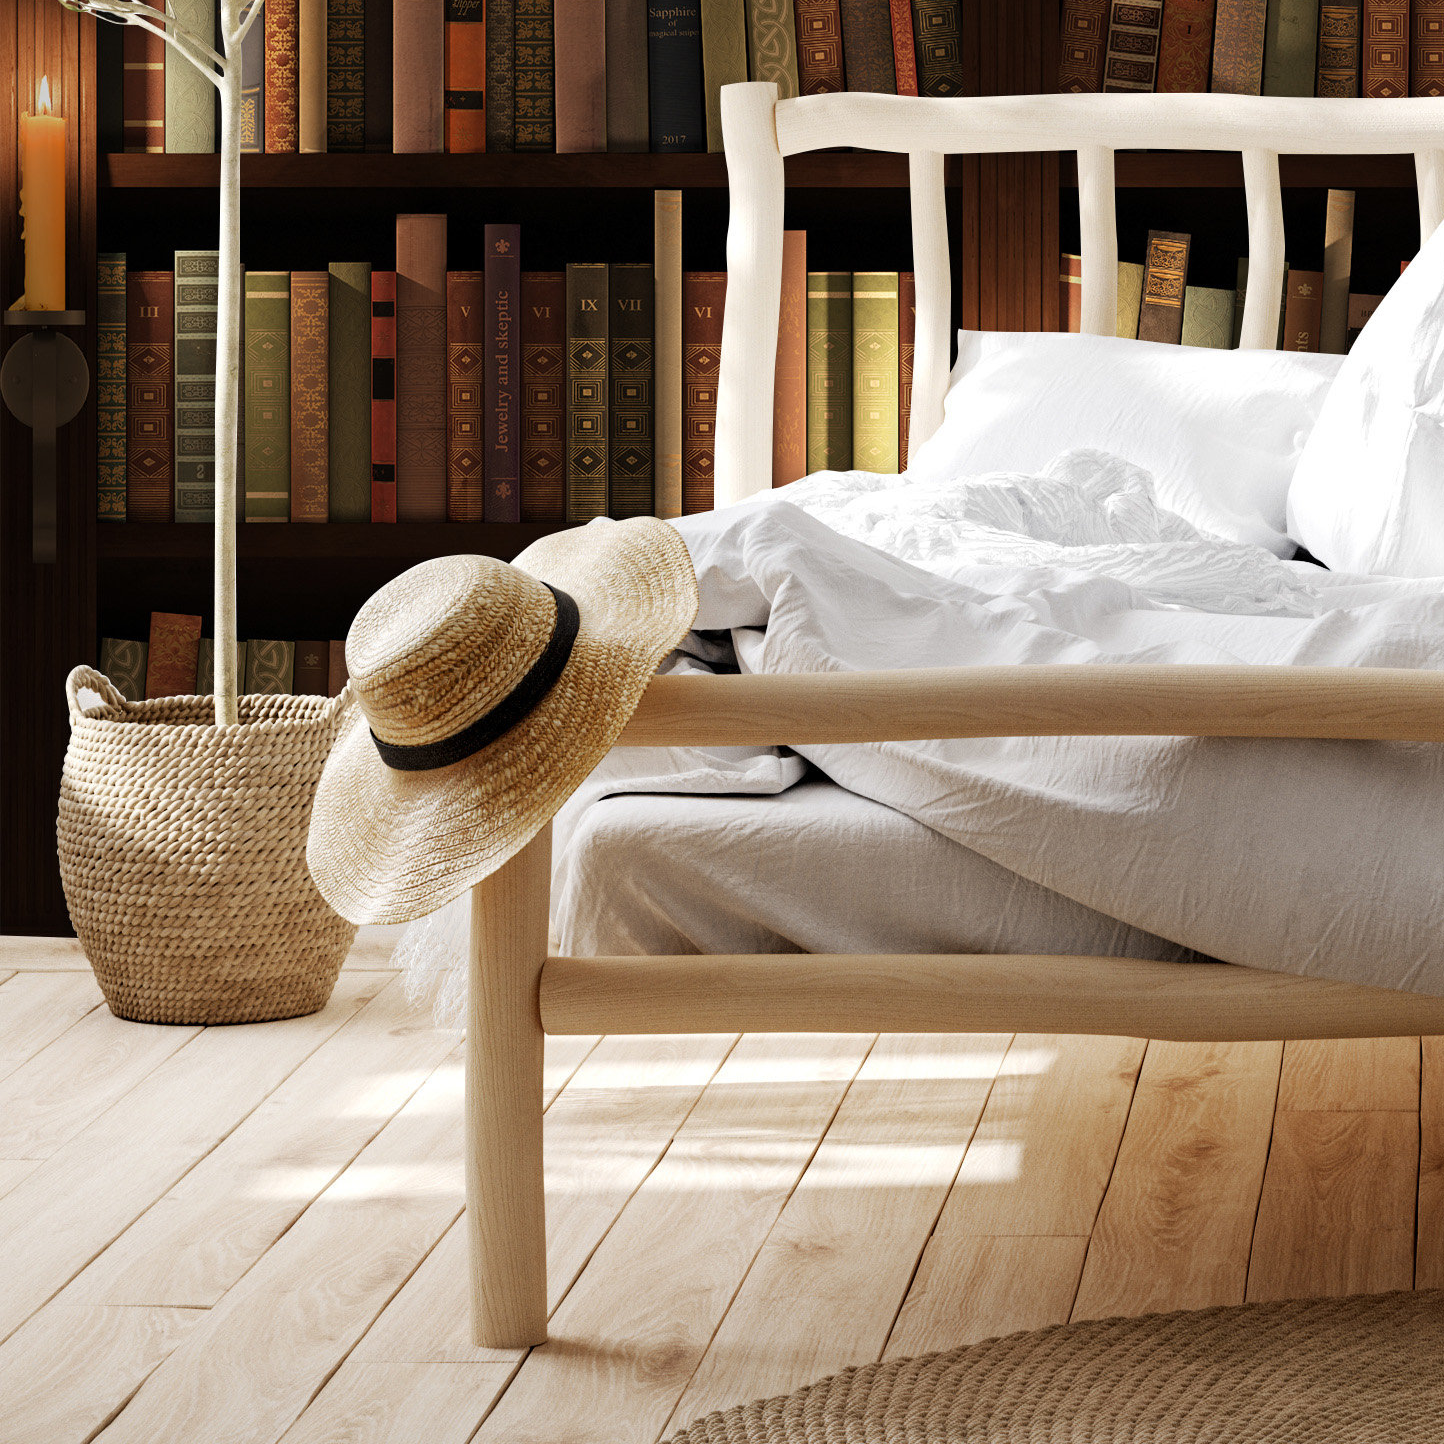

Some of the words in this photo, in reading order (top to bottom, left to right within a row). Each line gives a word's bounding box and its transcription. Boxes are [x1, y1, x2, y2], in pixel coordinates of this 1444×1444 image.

[649, 6, 697, 20] Sapphire
[648, 29, 678, 39] magical
[662, 134, 687, 145] 2017
[580, 298, 599, 311] IX
[617, 298, 642, 311] VII
[139, 306, 160, 318] III
[460, 306, 472, 318] V
[532, 306, 552, 318] VI
[694, 306, 712, 318] VI
[495, 290, 512, 347] skeptic
[495, 355, 508, 386] and
[495, 389, 512, 452] Jewelry
